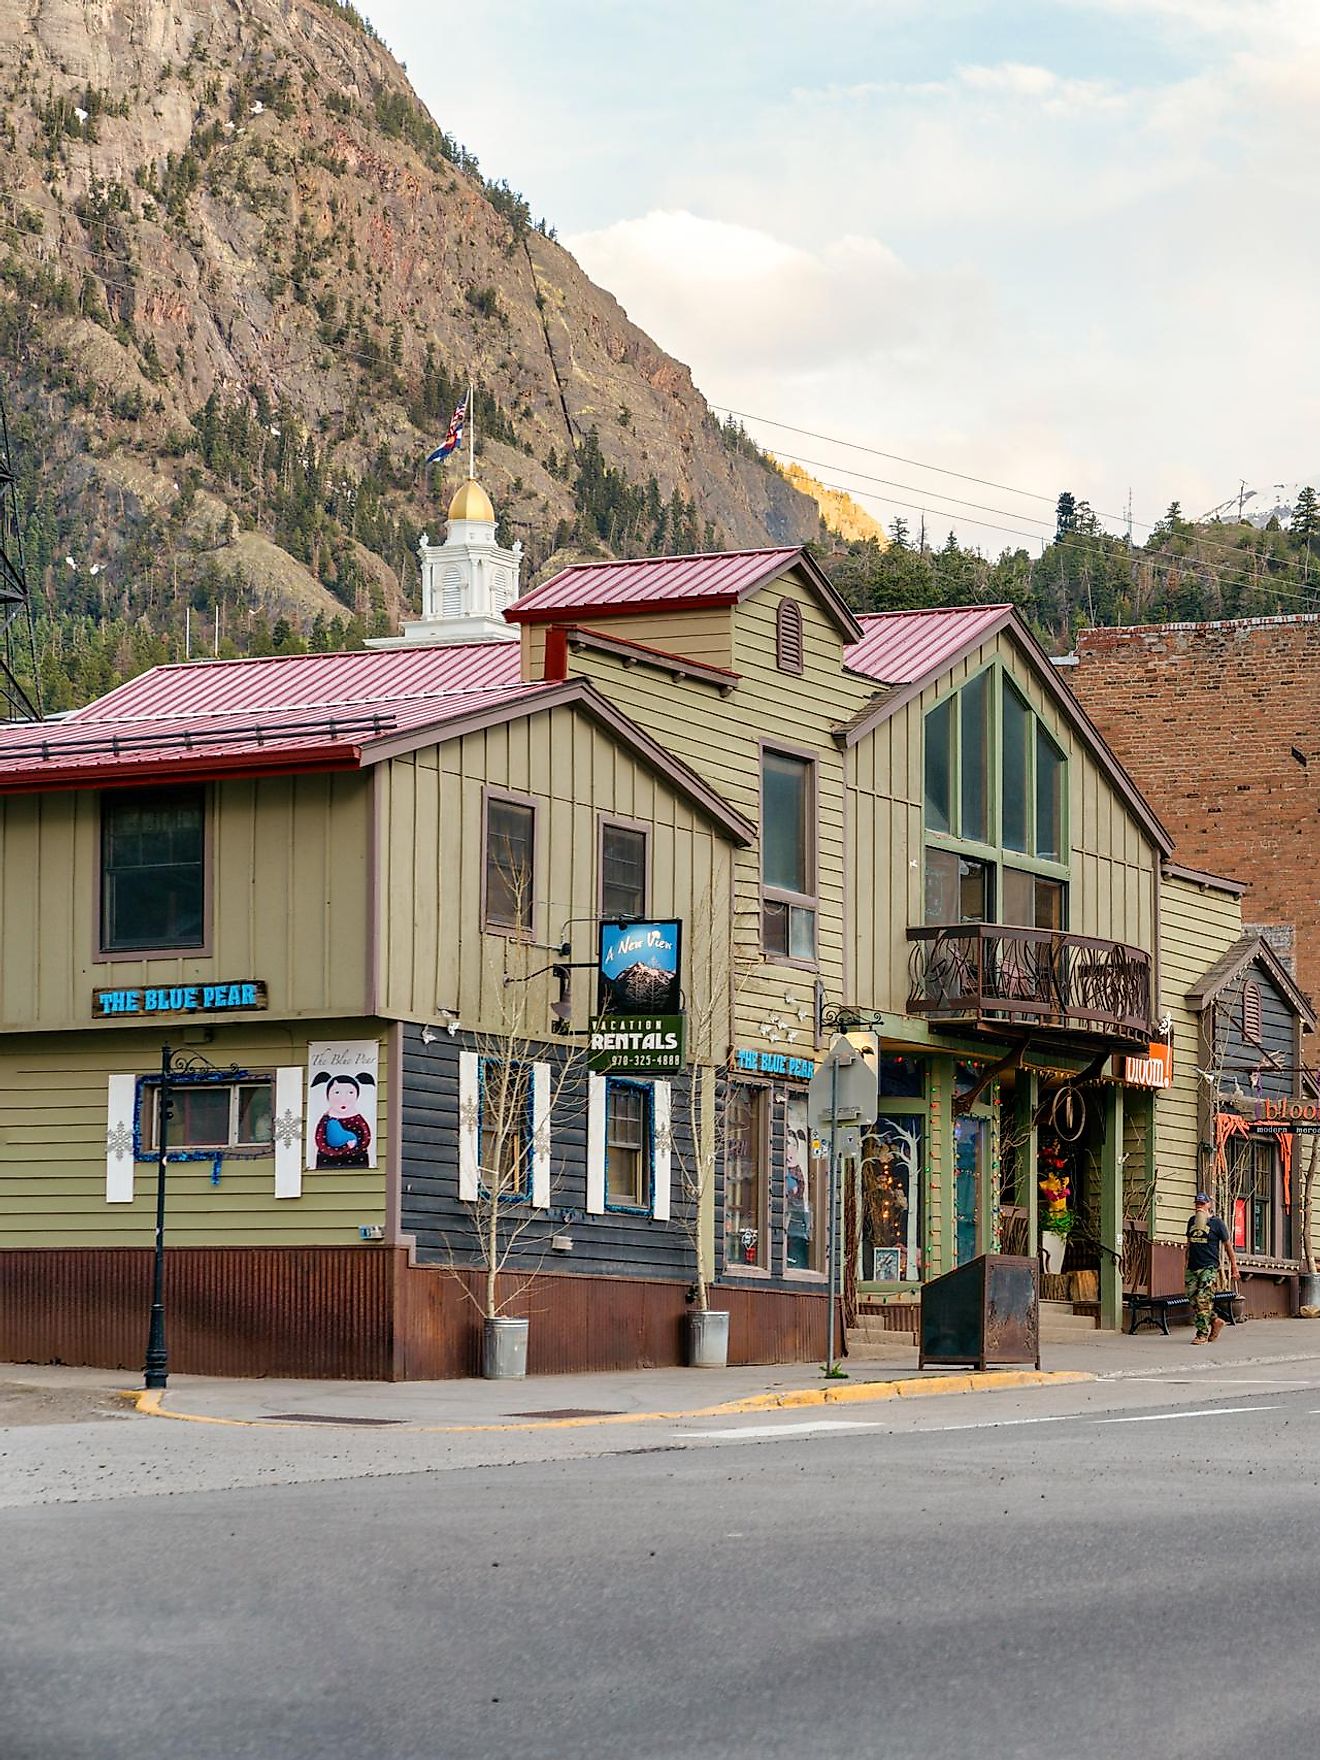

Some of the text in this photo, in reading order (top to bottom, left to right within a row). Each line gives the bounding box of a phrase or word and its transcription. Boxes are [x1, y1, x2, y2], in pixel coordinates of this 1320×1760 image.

[98, 984, 257, 1014] THE BLUE PEAR
[592, 1020, 662, 1031] VACATION
[591, 1032, 678, 1050] RENTALS
[737, 1048, 815, 1079] THE BLUE PEAR
